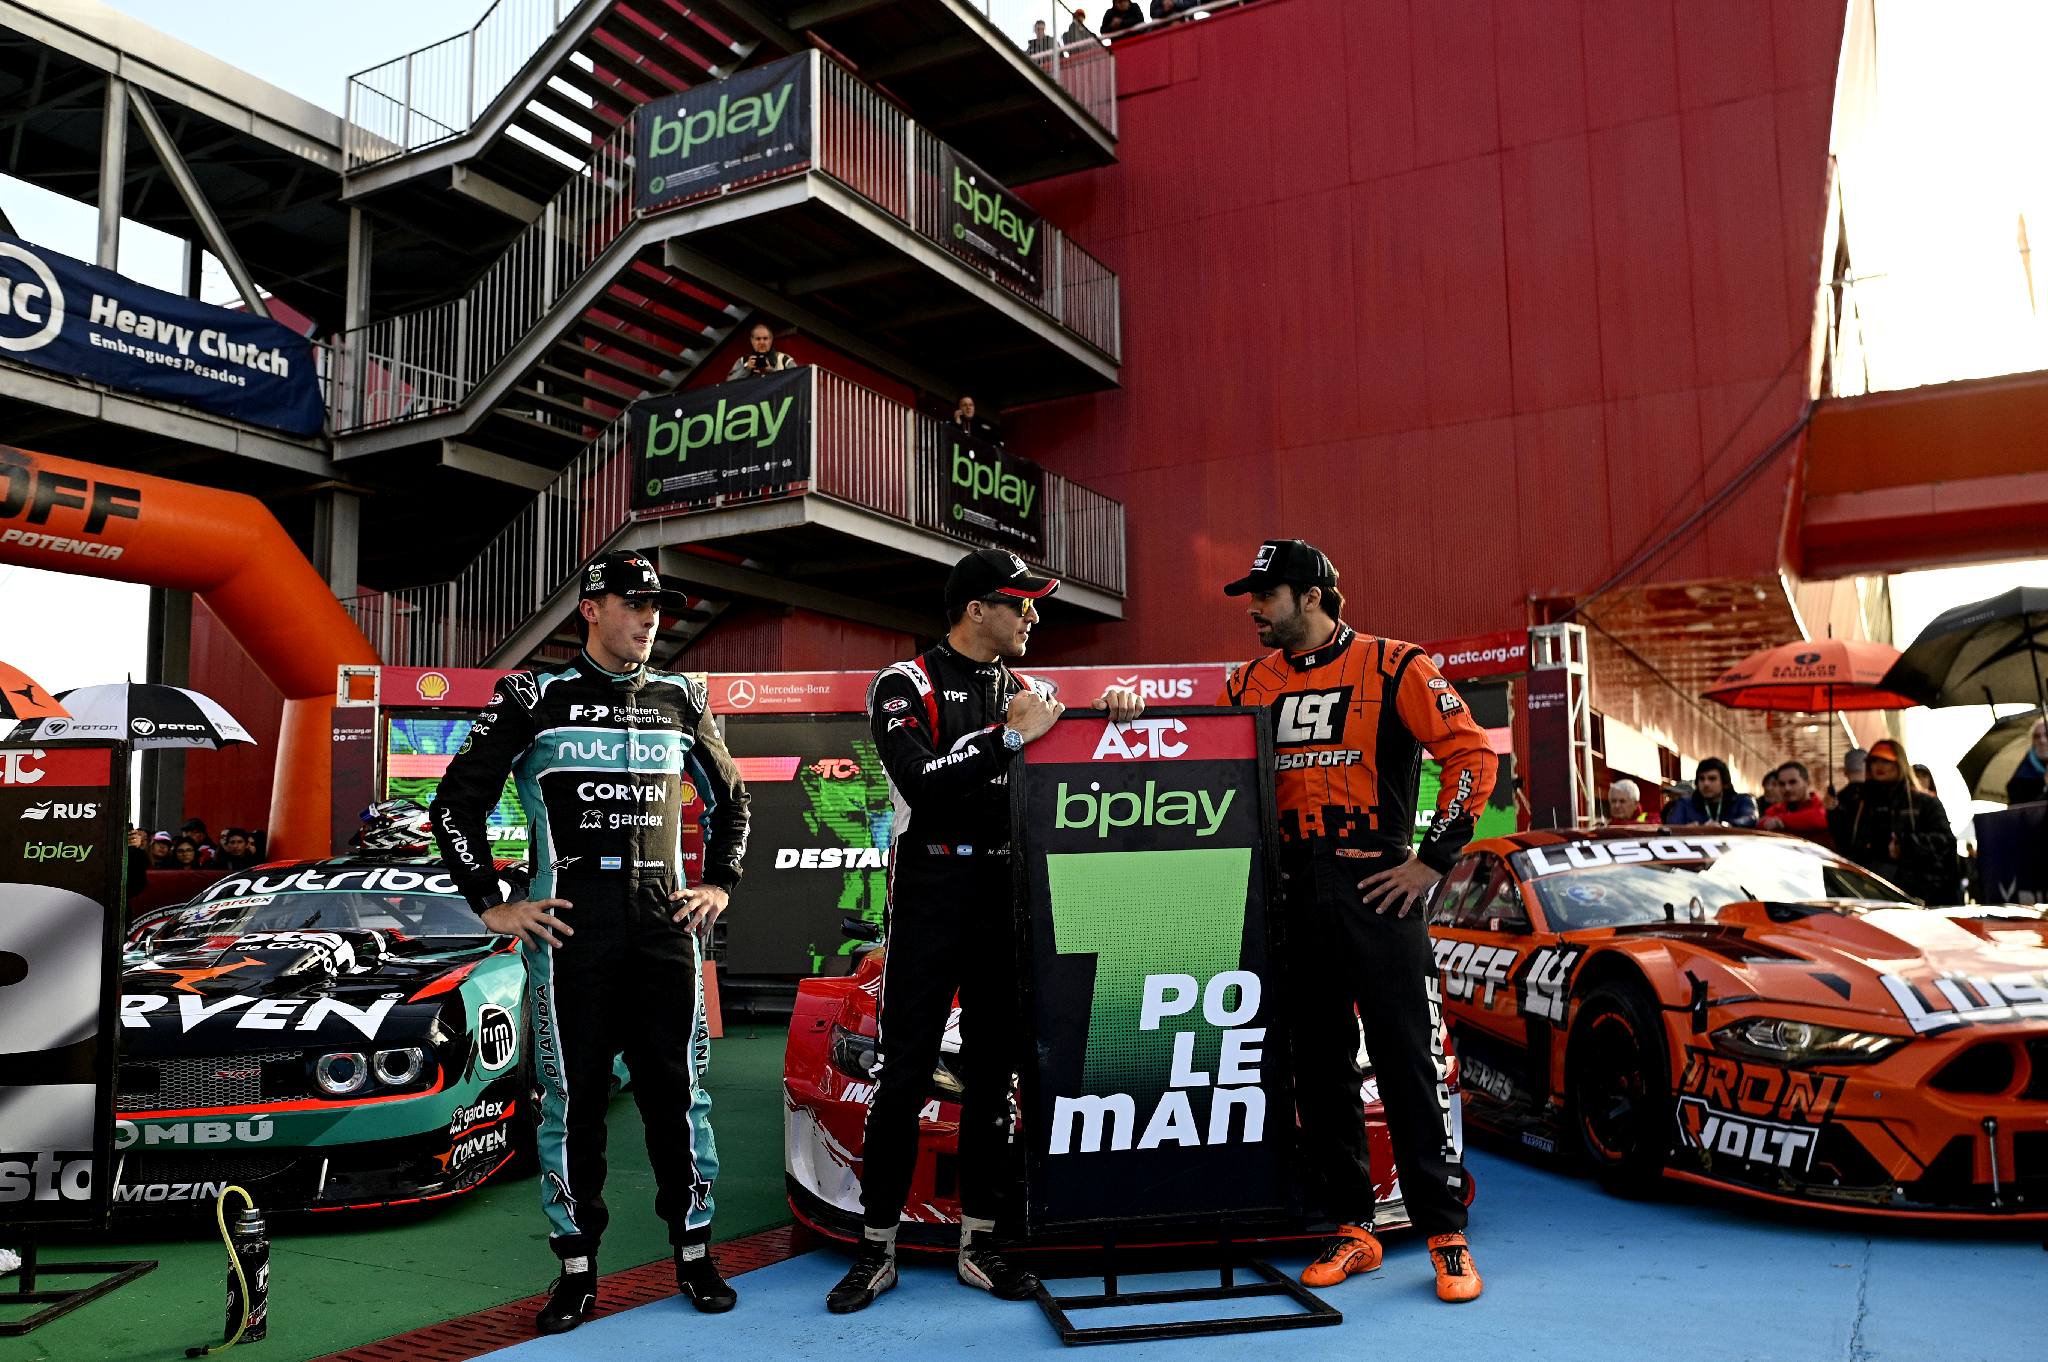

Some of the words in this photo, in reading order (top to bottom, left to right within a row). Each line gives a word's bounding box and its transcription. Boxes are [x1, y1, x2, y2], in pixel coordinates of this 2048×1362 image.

[649, 83, 794, 159] bplay
[953, 166, 1034, 257] bplay
[90, 294, 194, 356] Heavy
[200, 329, 288, 378] Clutch
[90, 332, 182, 369] Embragues
[184, 358, 246, 387] Pesados
[646, 396, 794, 462] bplay
[952, 443, 1036, 519] bplay
[1, 529, 124, 560] POTENCIA
[1449, 645, 1526, 666] actc.org.ar
[760, 684, 830, 694] Mercedes-Benz
[943, 690, 968, 703] YPF
[1140, 679, 1193, 699] RUS
[158, 723, 205, 731] FOTON
[1092, 718, 1189, 760] ACTC
[817, 758, 854, 779] TC
[53, 803, 97, 819] RUS
[577, 781, 666, 803] CORVEN
[1055, 781, 1236, 838] bplay
[609, 812, 663, 829] gardex
[23, 841, 93, 863] bplay
[208, 896, 272, 911] gardex
[1139, 970, 1262, 1031] PO
[1169, 1027, 1266, 1087] LE
[1464, 1055, 1515, 1101] SERIES
[1685, 1045, 1849, 1124] IRON
[463, 1100, 504, 1129] gardex
[451, 1123, 507, 1170] CORVEN
[1696, 1116, 1809, 1168] VOLT
